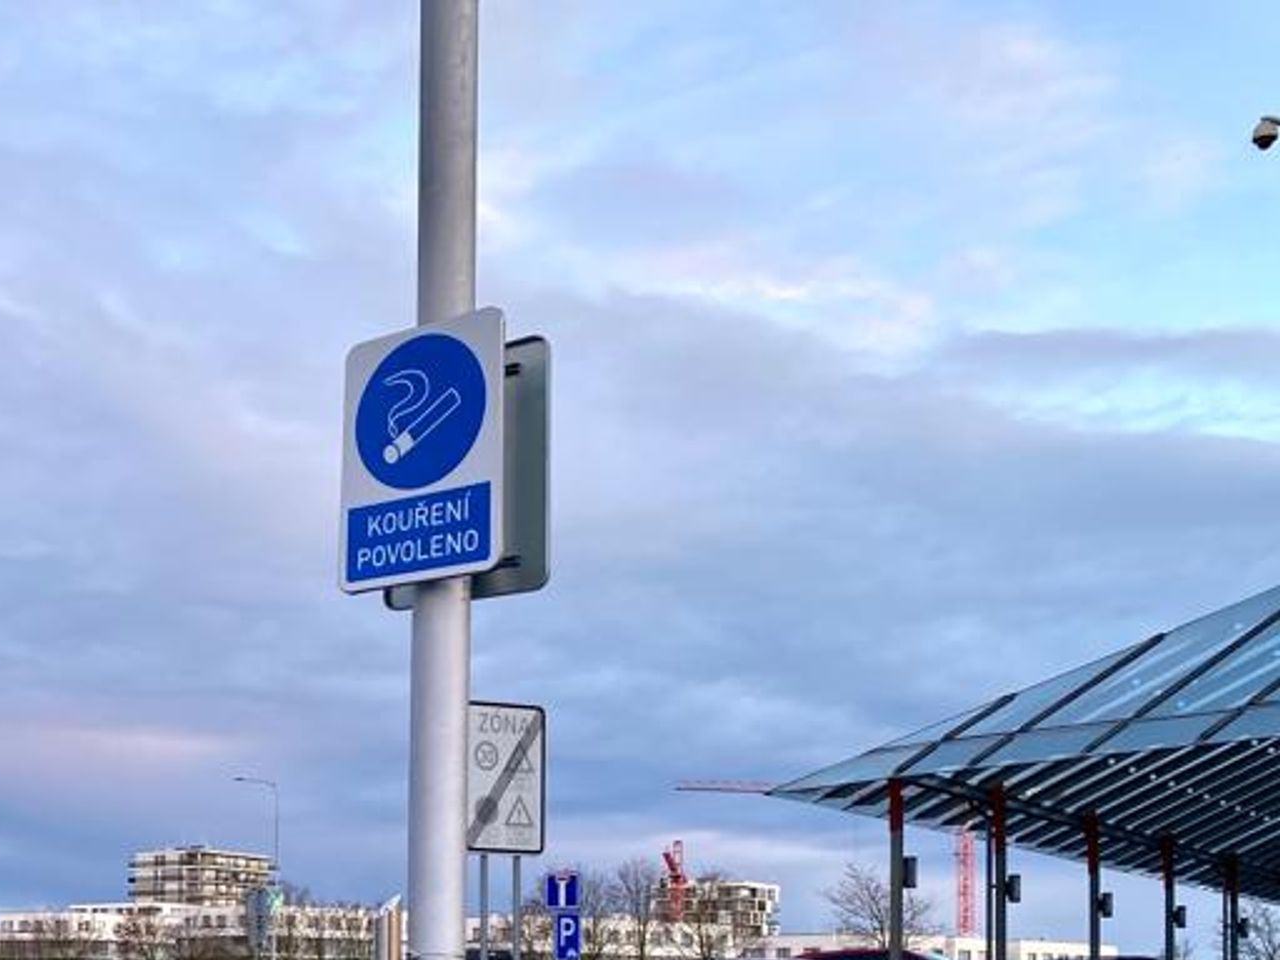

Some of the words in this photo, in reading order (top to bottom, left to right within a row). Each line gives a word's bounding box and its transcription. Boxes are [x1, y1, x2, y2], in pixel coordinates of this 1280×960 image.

[367, 490, 471, 537] KOUŘENÍ
[357, 529, 479, 572] POVOLENO
[560, 917, 576, 947] P
